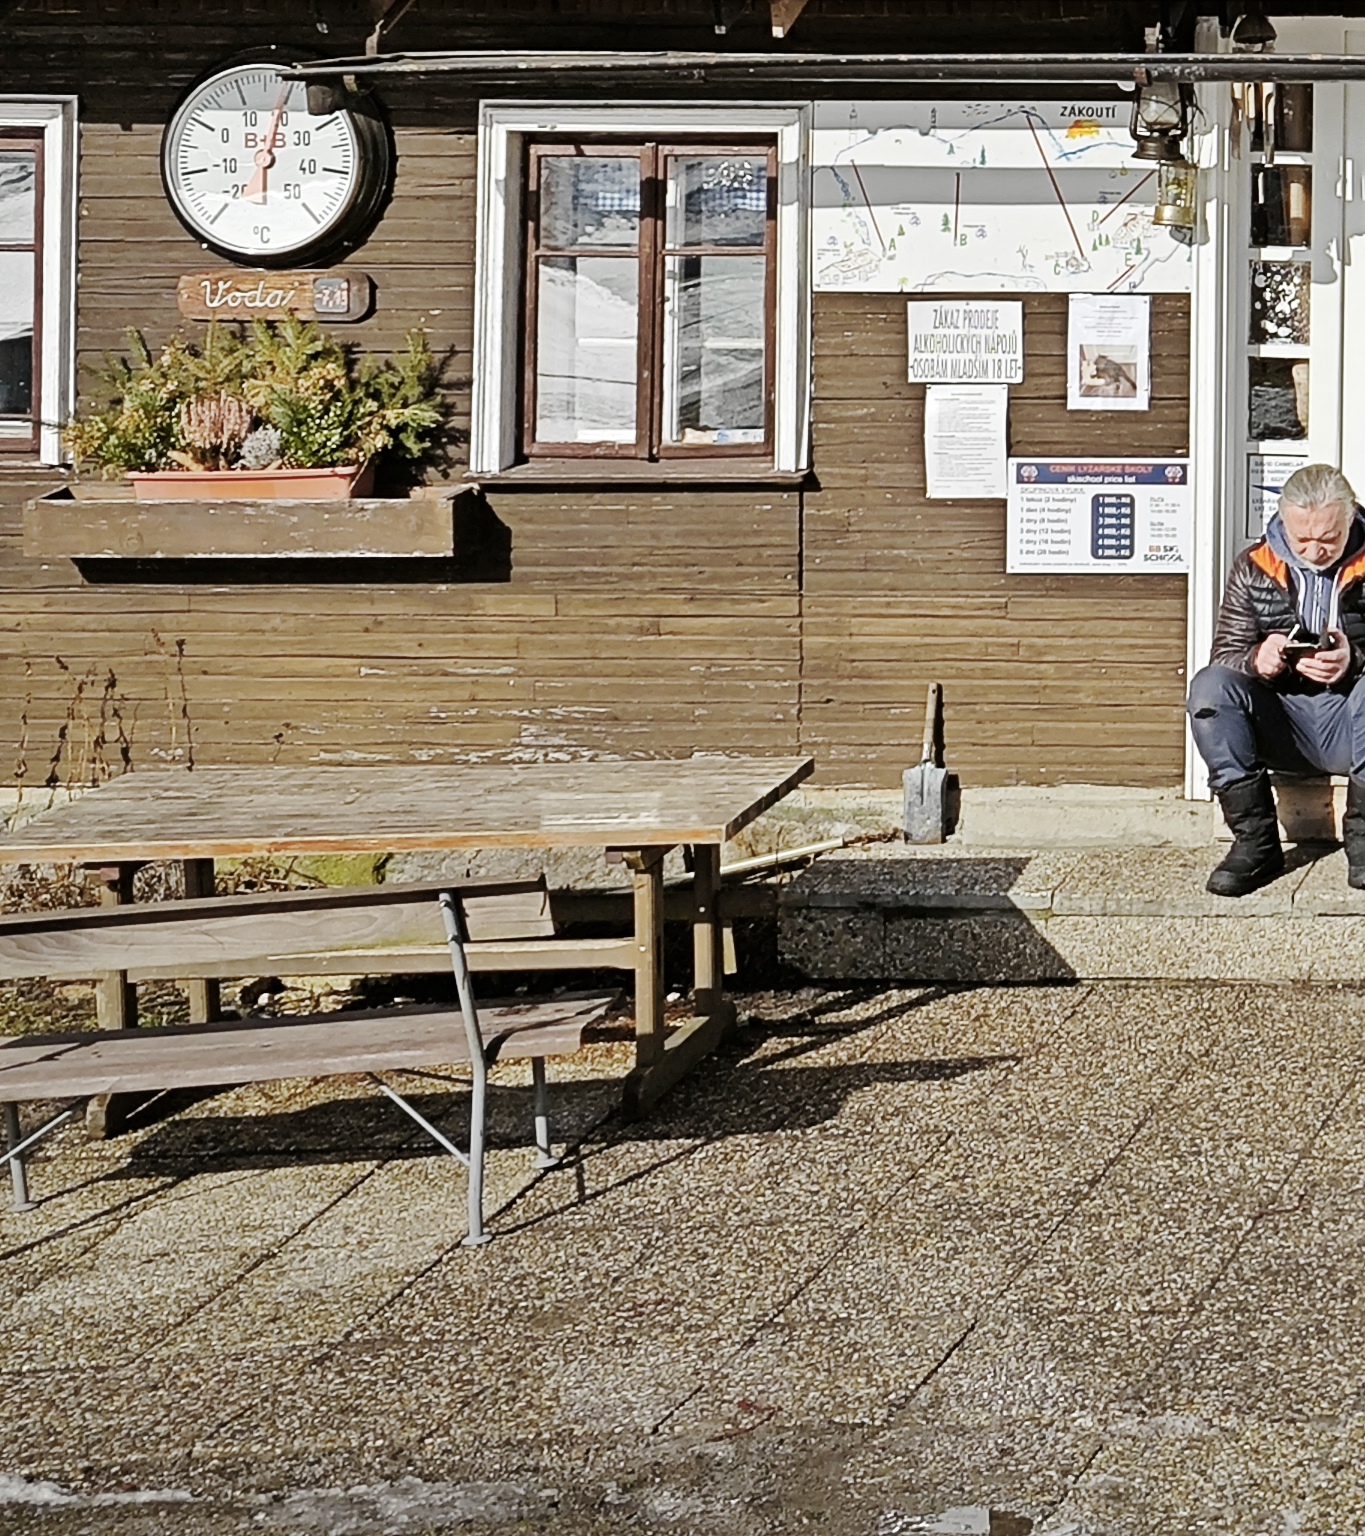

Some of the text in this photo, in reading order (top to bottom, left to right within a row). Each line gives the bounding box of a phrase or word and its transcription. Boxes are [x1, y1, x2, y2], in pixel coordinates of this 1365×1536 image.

[1060, 103, 1117, 118] ZÁKOUTÍ
[242, 111, 257, 127] 10
[271, 111, 289, 127] 0
[221, 128, 229, 143] 0
[293, 130, 311, 146] 30
[212, 157, 237, 174] -10
[299, 158, 317, 175] 40
[284, 183, 301, 200] 50
[253, 225, 271, 244] °C
[960, 234, 967, 246] B
[933, 305, 999, 329] ZÁKAZ PRODEJE
[913, 329, 1017, 354] ALKOHOLICKÝCH NÁPOJŮ
[913, 354, 948, 378] OSOBÁM
[992, 359, 1002, 379] 18
[1005, 359, 1018, 379] LET
[1104, 475, 1123, 483] price
